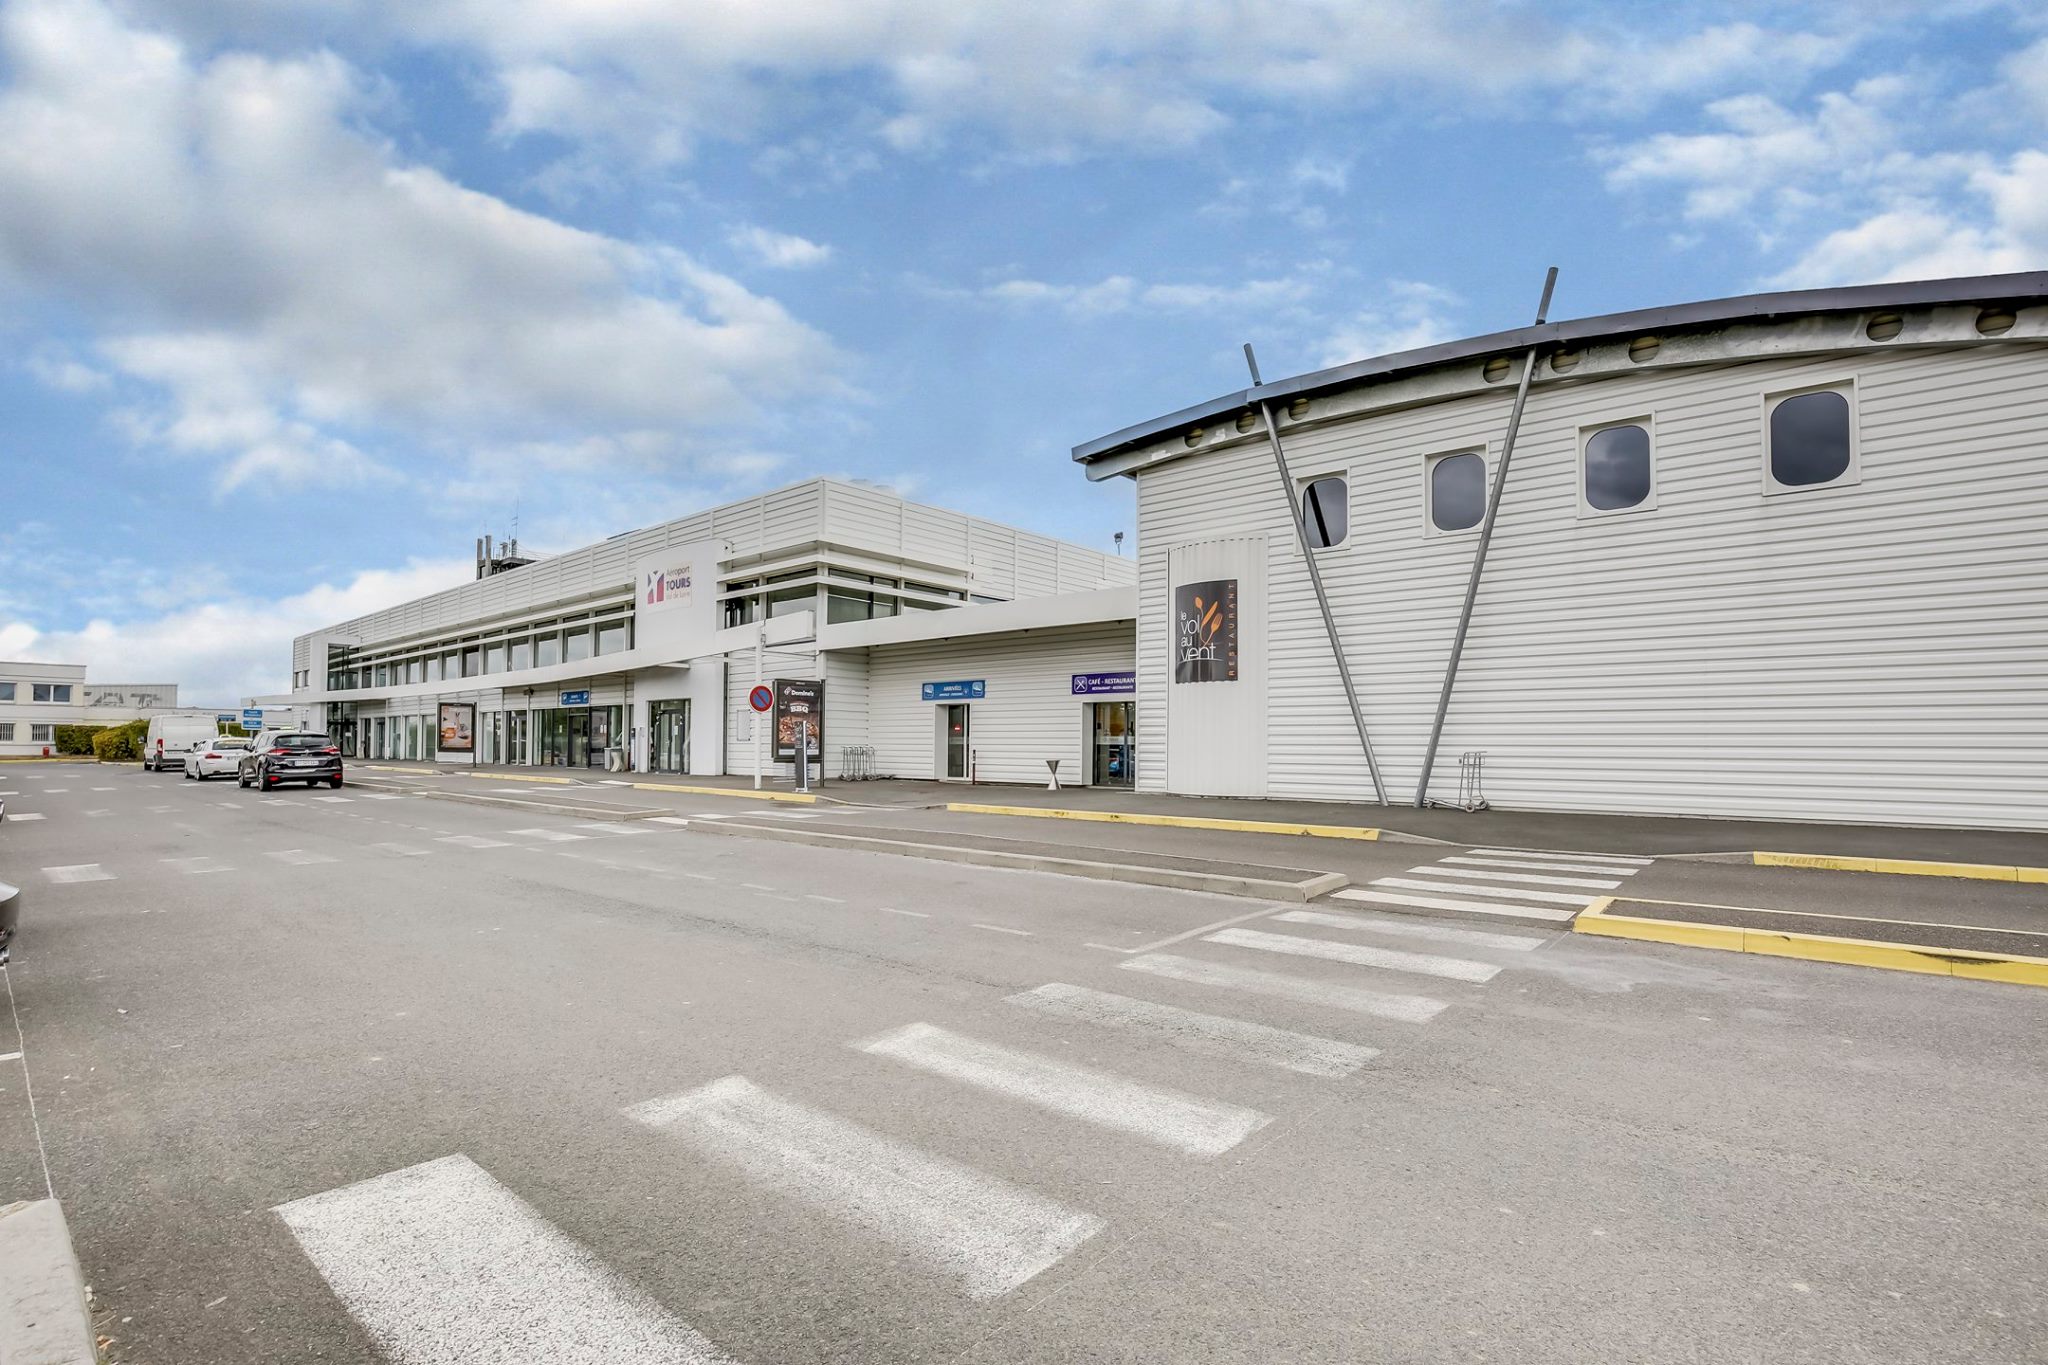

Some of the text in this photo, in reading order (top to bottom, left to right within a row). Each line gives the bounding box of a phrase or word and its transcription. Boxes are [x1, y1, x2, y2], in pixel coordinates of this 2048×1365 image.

[666, 576, 691, 591] TOURS
[1181, 610, 1187, 621] le
[1180, 614, 1200, 635] vol
[1228, 584, 1236, 676] RESTAURANT
[1181, 635, 1193, 647] au
[1180, 642, 1217, 661] vent
[1088, 677, 1101, 685] CAFÉ
[790, 705, 809, 713] BBQ
